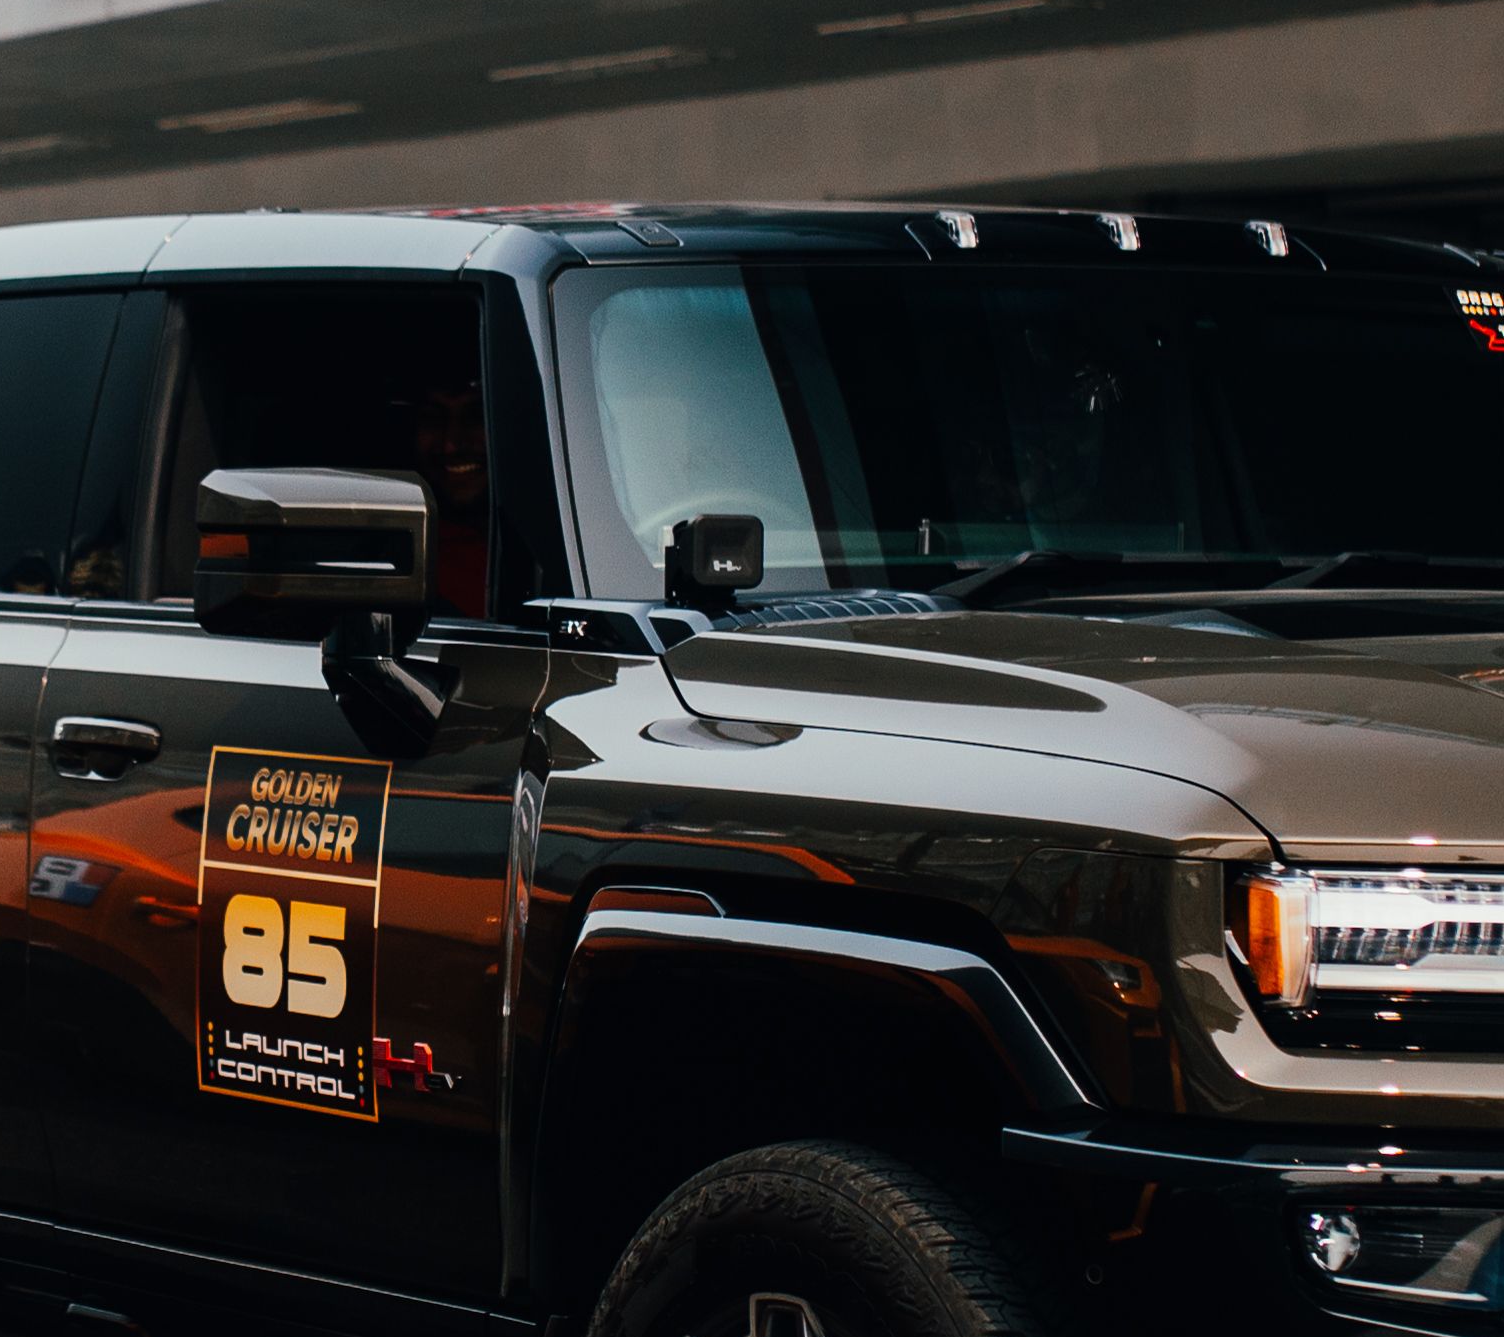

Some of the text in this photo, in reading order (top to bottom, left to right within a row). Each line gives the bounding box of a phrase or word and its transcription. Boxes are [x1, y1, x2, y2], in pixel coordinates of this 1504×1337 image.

[251, 767, 343, 809] GOLDEN
[226, 804, 359, 864] CRUISER
[222, 893, 347, 1019] 85
[225, 1029, 346, 1068] LAUNCH
[217, 1058, 356, 1100] CONTROL
